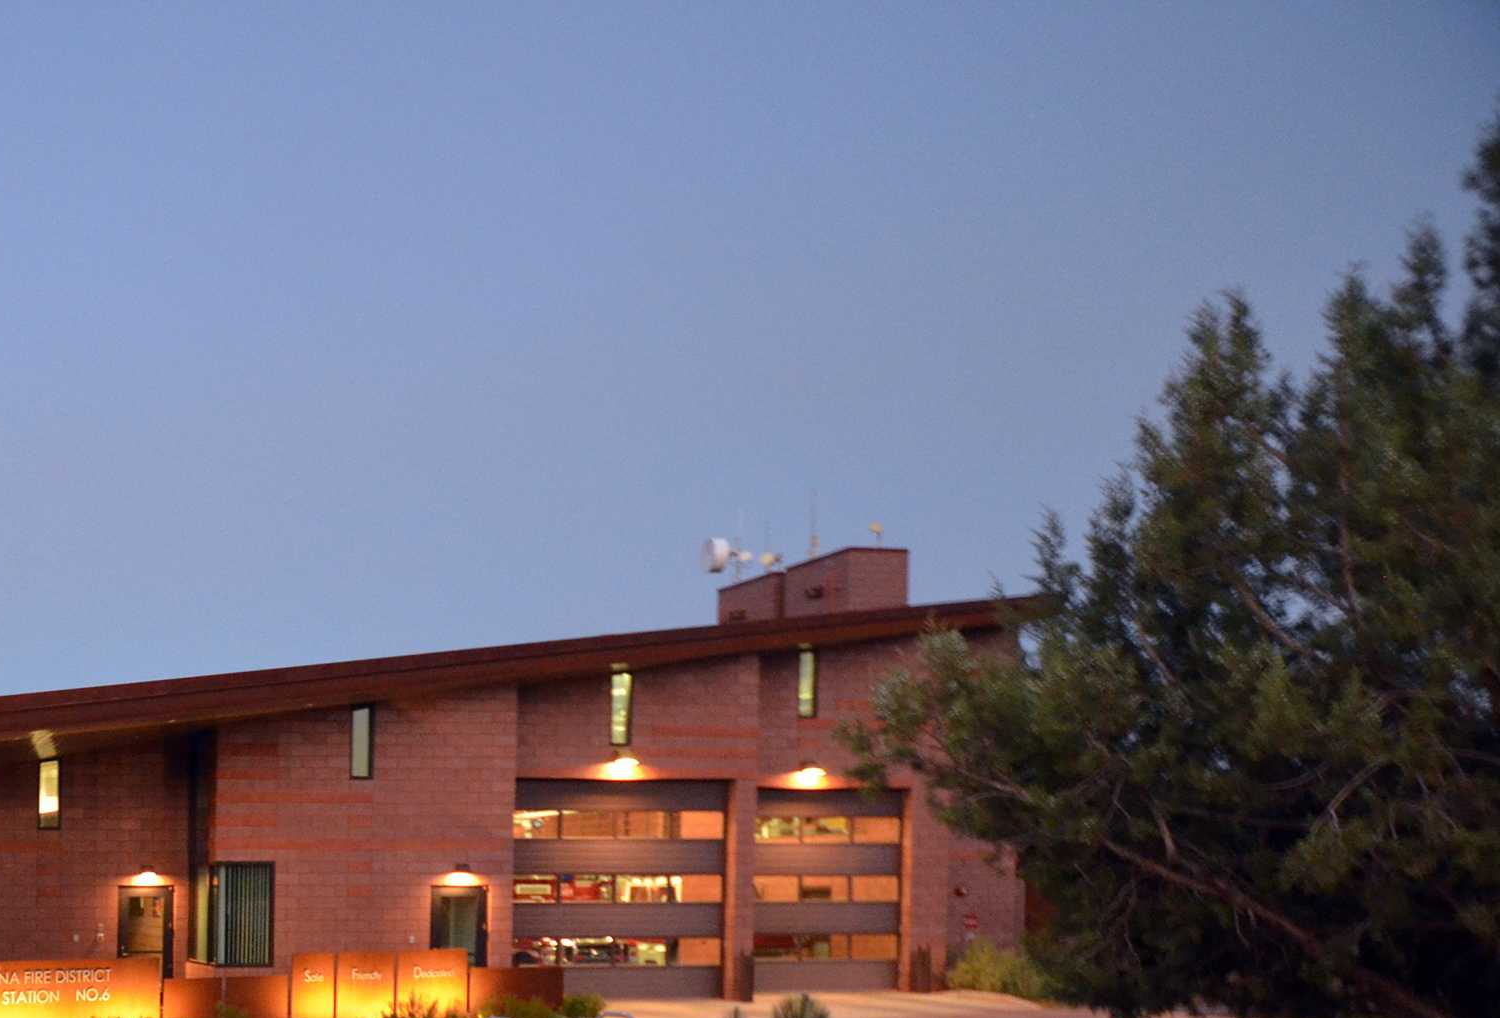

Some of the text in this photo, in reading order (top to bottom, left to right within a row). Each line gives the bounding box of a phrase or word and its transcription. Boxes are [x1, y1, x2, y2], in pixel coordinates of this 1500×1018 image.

[24, 970, 52, 985] FIRE
[55, 968, 112, 983] DISTRICT
[2, 989, 60, 1005] STATION
[75, 987, 111, 1002] NO.6
